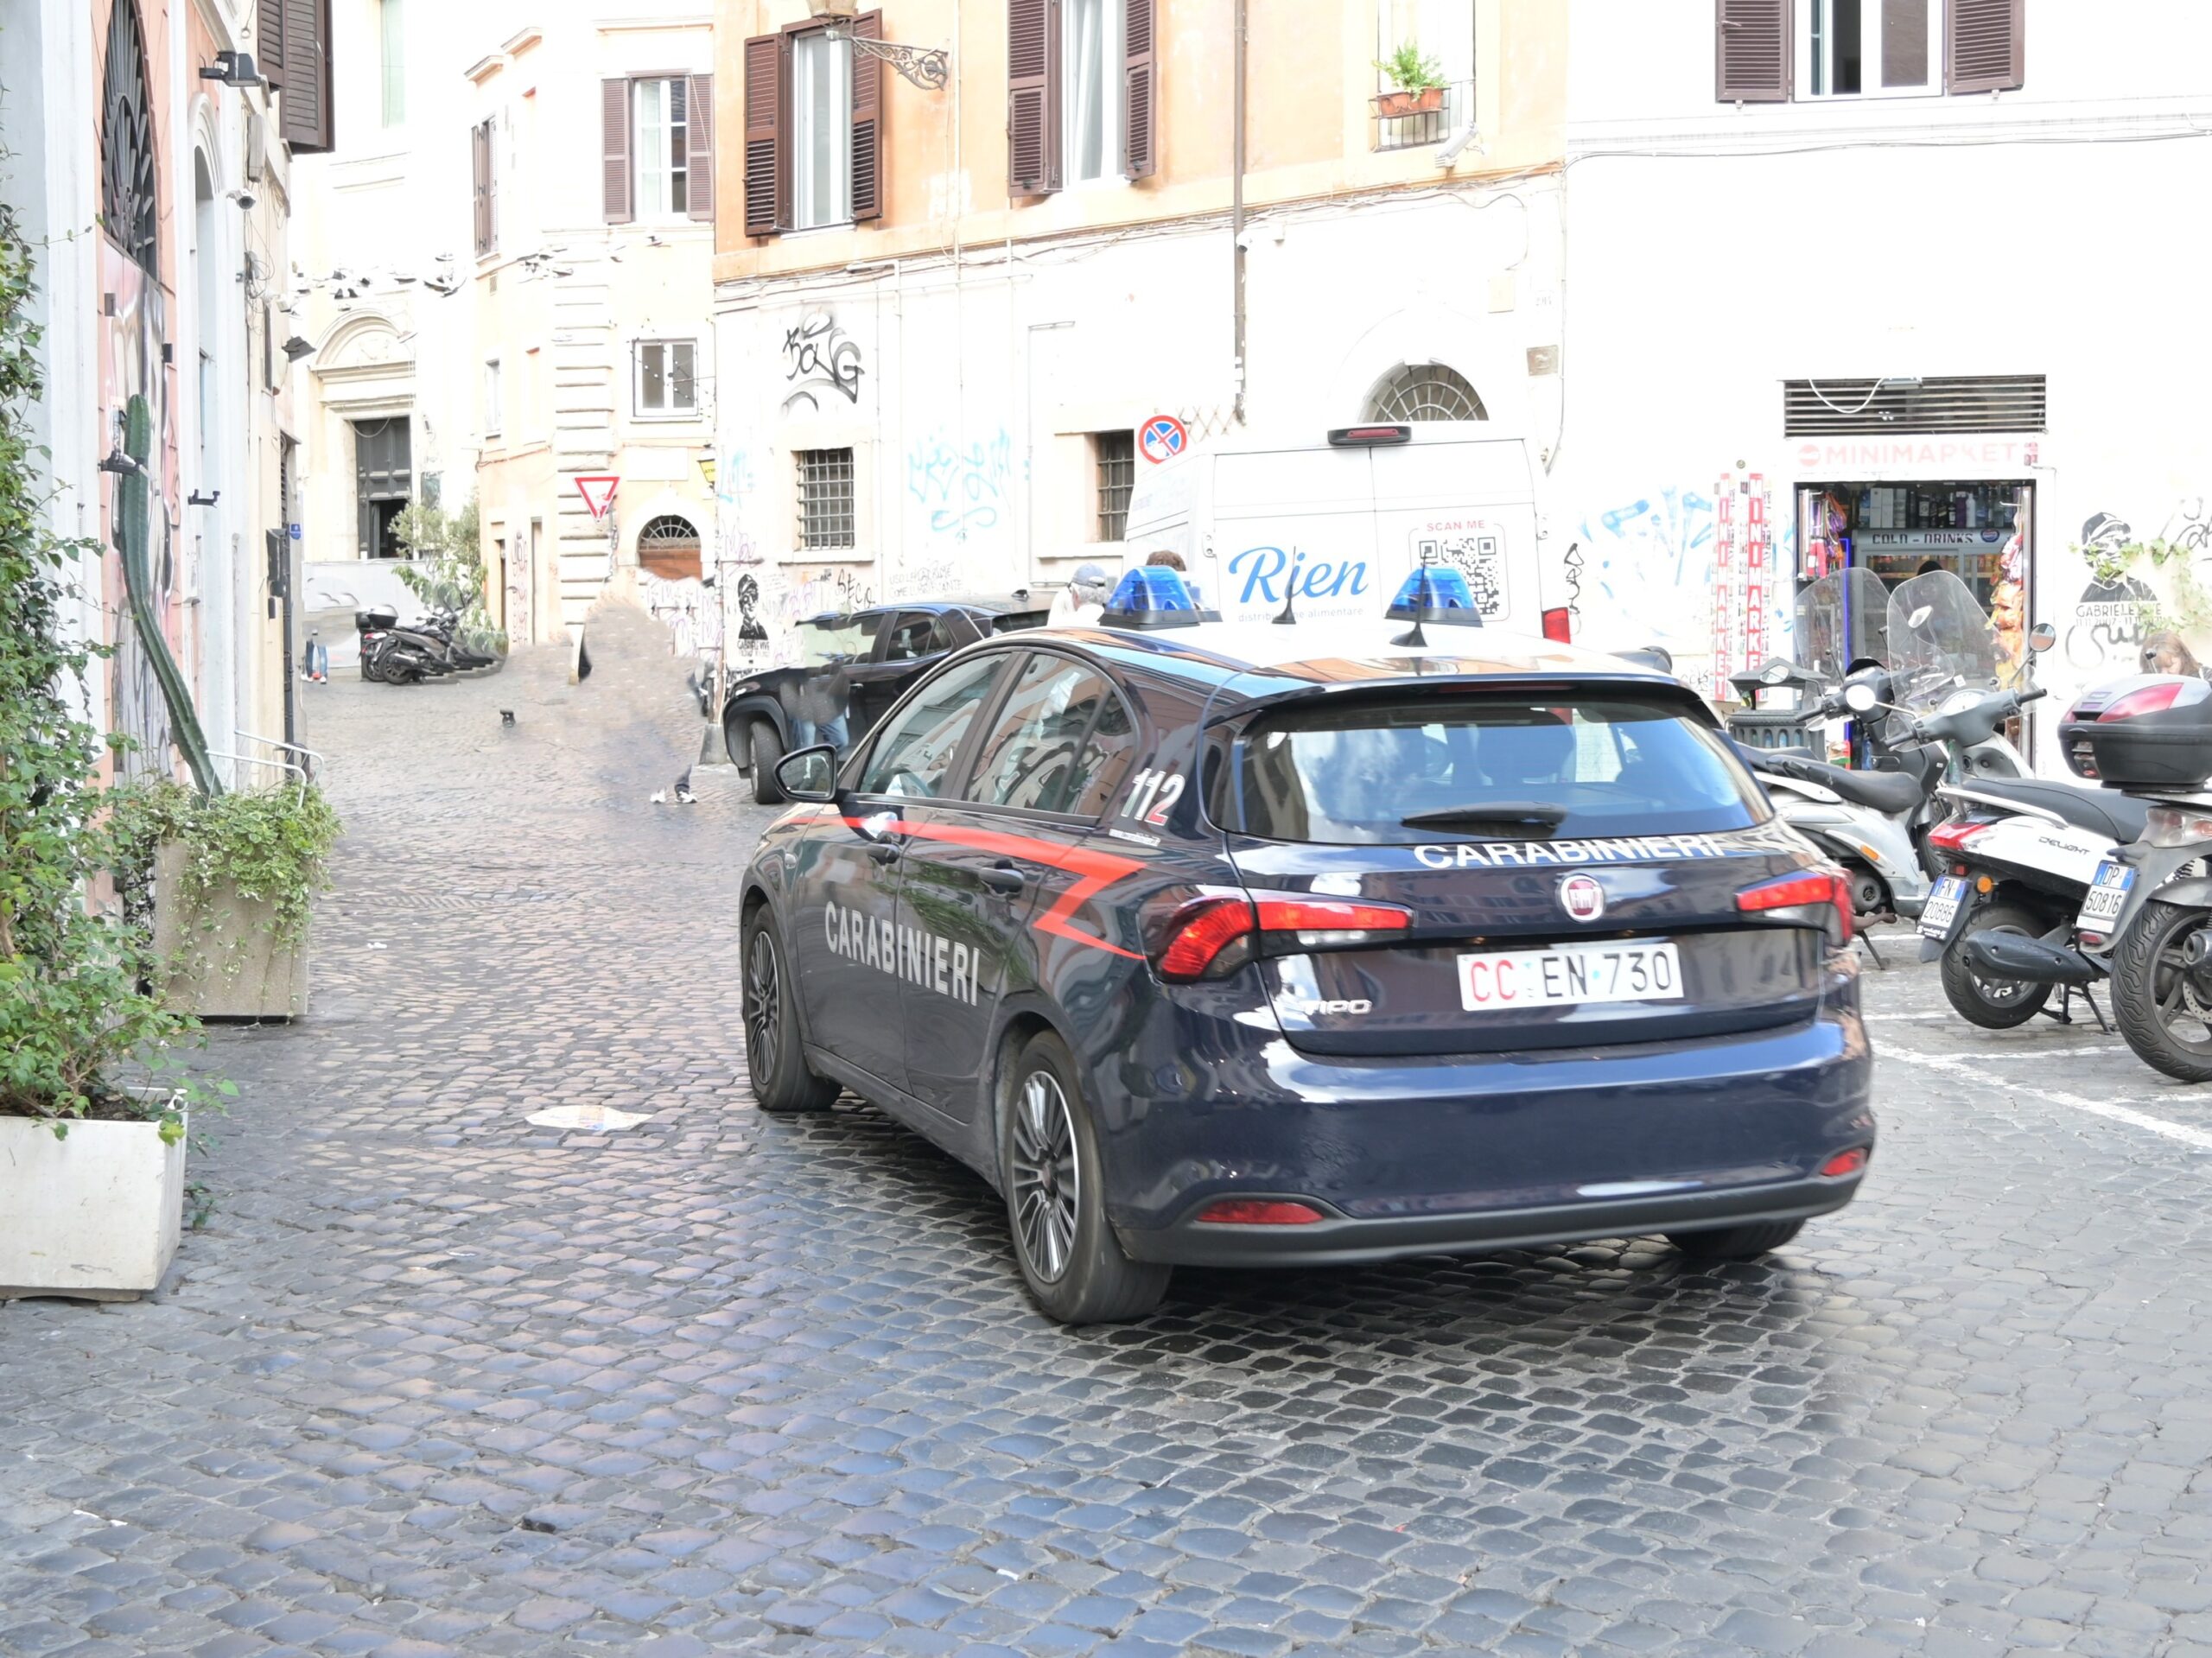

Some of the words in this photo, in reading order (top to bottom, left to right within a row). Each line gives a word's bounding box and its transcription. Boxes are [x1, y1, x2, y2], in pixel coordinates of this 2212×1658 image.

[1826, 441, 2018, 465] MINIMARKET
[1427, 521, 1462, 532] SCAN
[1466, 519, 1485, 530] ME
[1228, 546, 1370, 603] Rien
[1748, 480, 1762, 671] MINIMARKE
[1307, 607, 1363, 619] alimentare
[1121, 768, 1185, 826] 112
[1414, 834, 1726, 869] CARABINIERI
[2038, 836, 2091, 855] DELIGHT
[2102, 866, 2120, 886] DP
[1941, 879, 1955, 897] FN
[1923, 901, 1955, 923] 20886
[2085, 891, 2122, 914] 50816
[825, 901, 980, 1006] CARABINIERI
[1471, 959, 1516, 1001] CC
[1541, 955, 1588, 998] EN
[1603, 950, 1671, 994] 730
